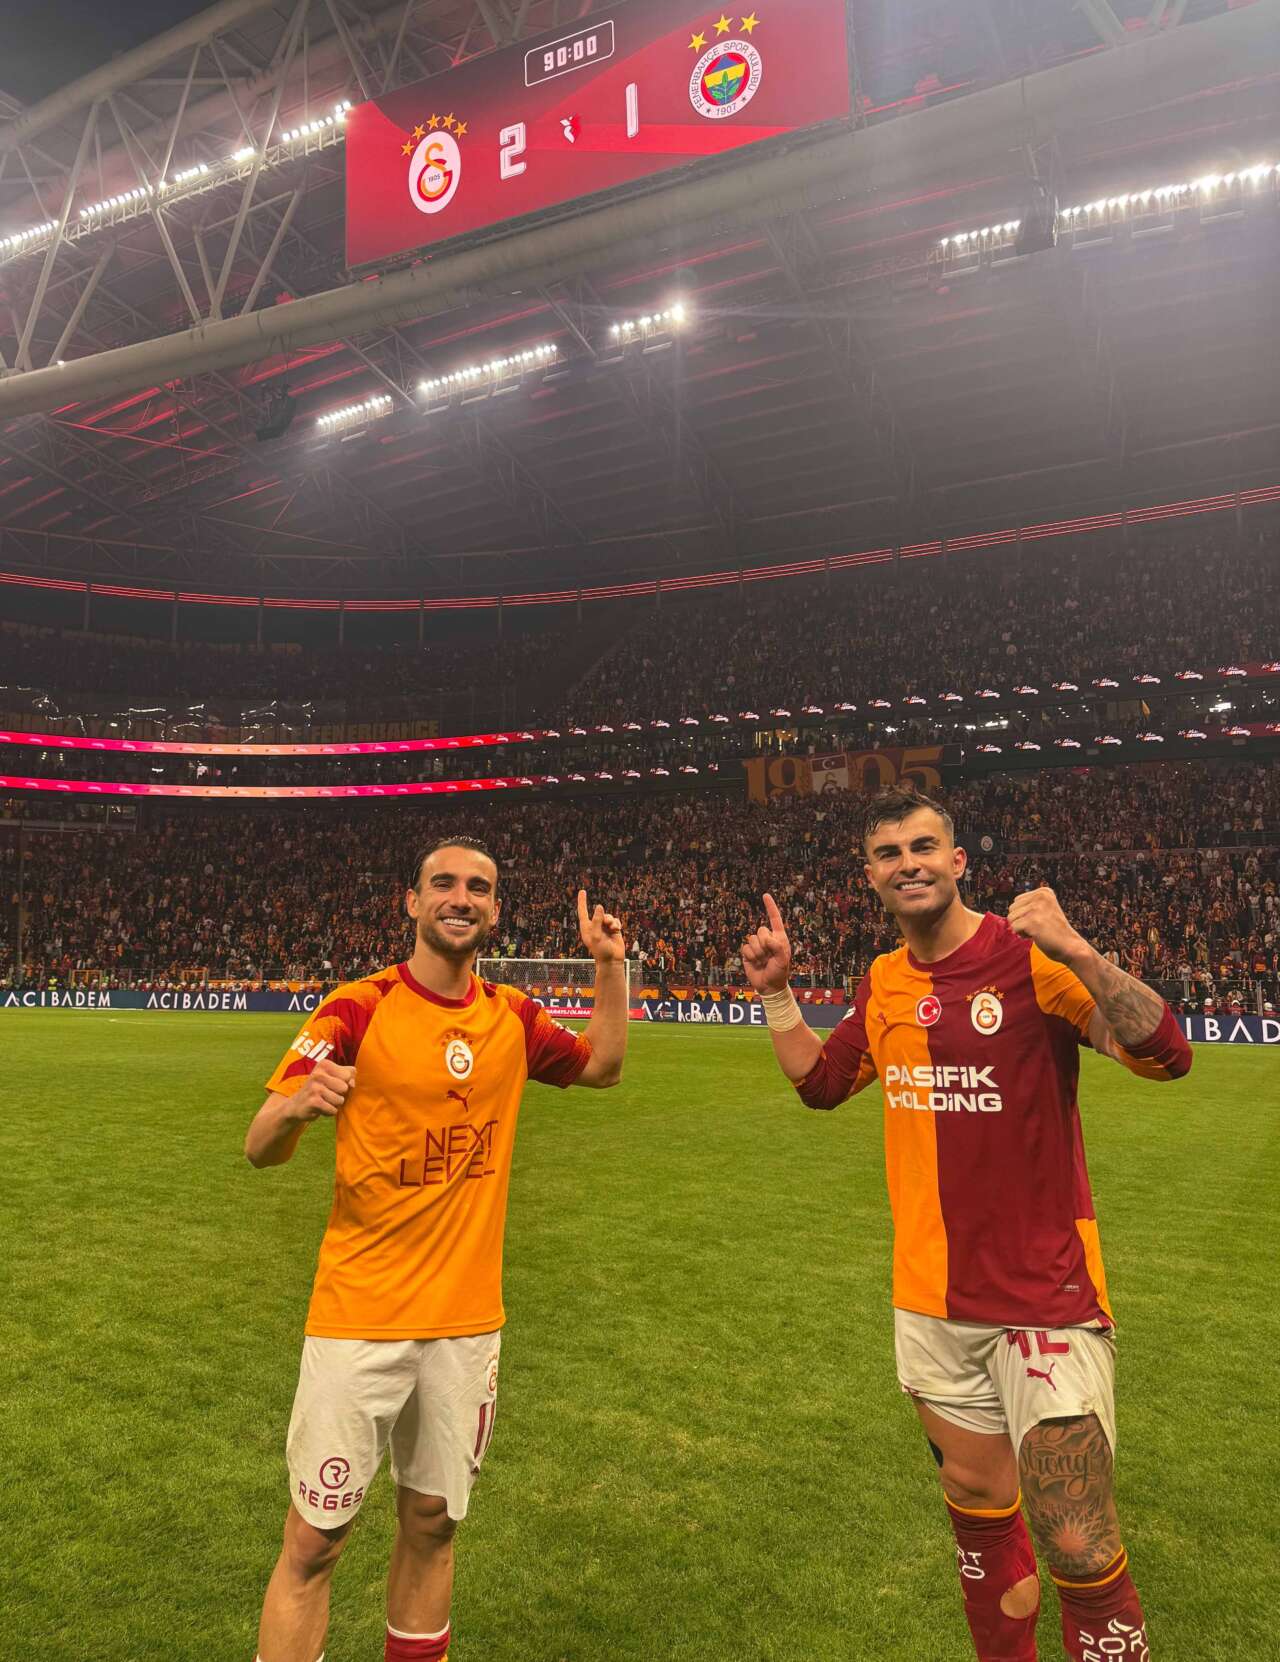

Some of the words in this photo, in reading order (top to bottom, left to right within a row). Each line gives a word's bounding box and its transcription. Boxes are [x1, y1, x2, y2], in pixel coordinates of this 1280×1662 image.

[543, 35, 597, 72] 90:00
[723, 41, 750, 54] SPOR
[716, 102, 737, 115] 1907
[499, 121, 527, 181] 2
[743, 745, 943, 804] 1905
[4, 991, 111, 1007] ACIBADEM
[146, 992, 247, 1010] ACIBADEM
[640, 1000, 763, 1024] ACIBADE
[425, 1119, 498, 1159] NEXT
[299, 1480, 364, 1511] REGES
